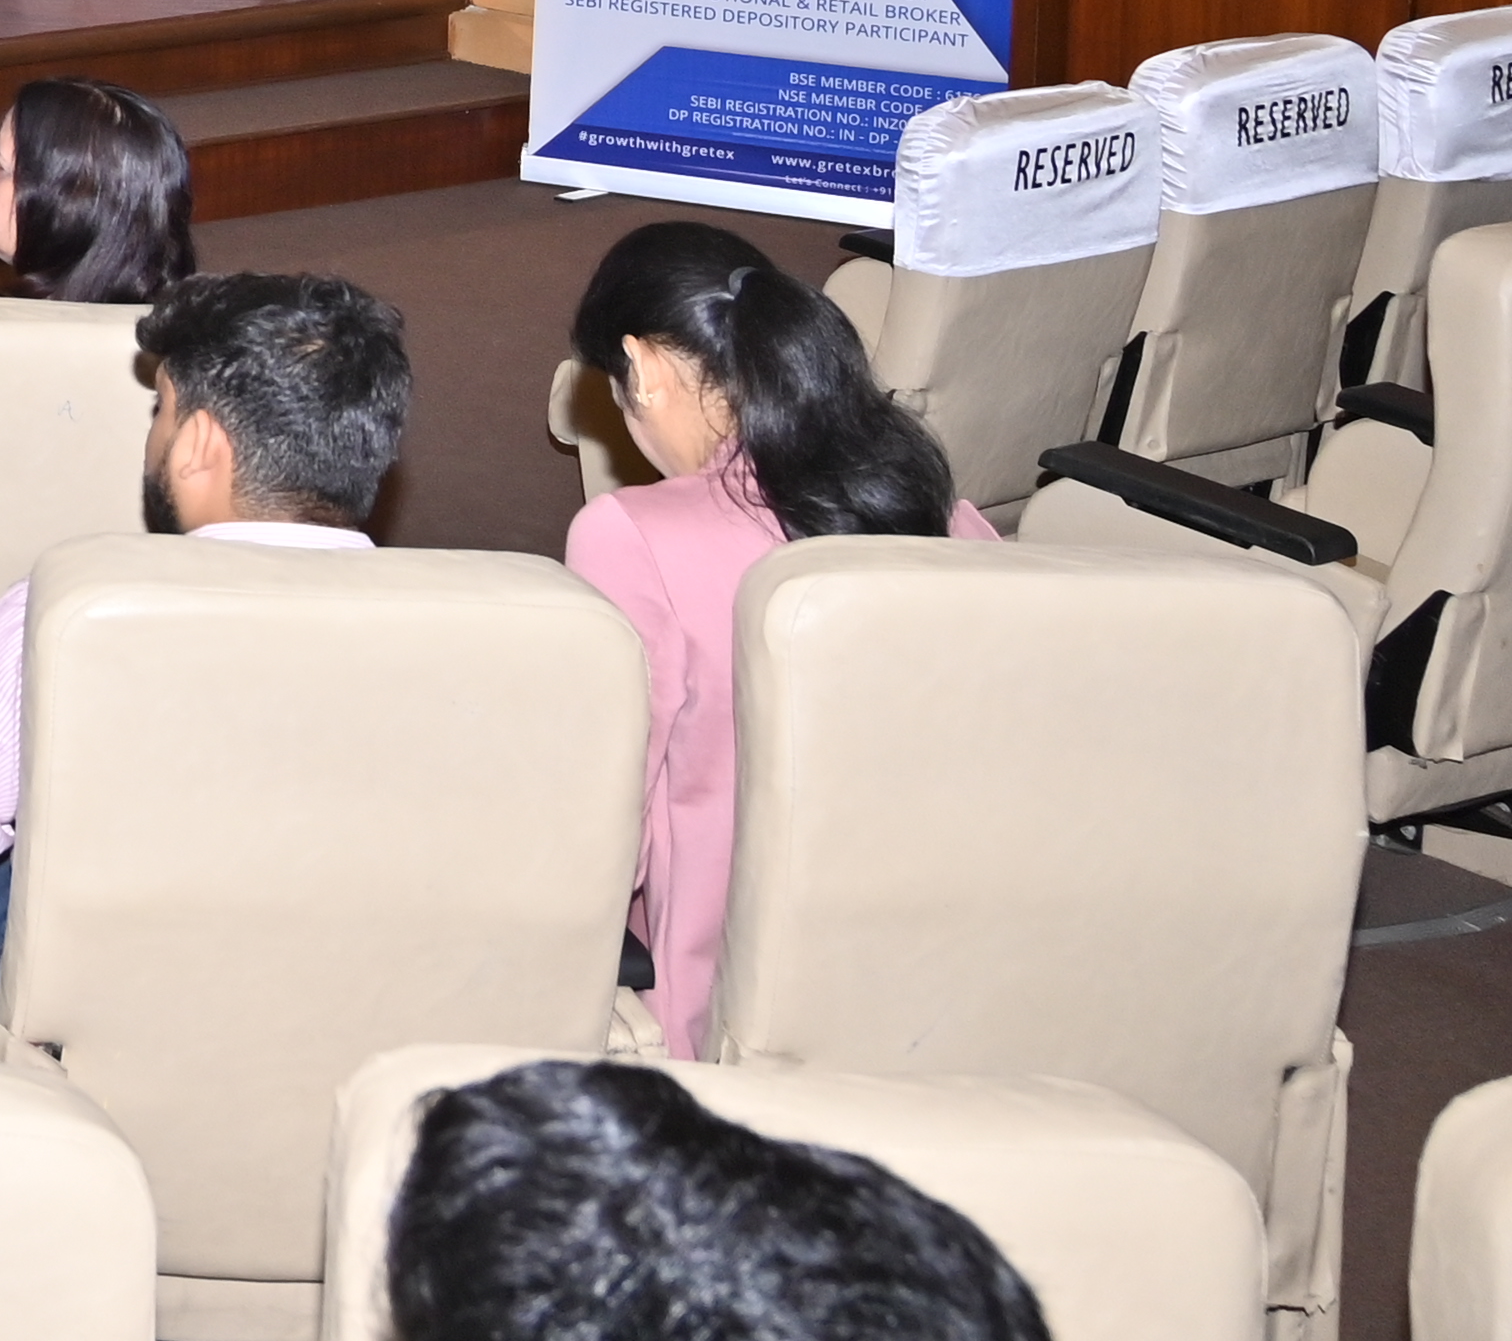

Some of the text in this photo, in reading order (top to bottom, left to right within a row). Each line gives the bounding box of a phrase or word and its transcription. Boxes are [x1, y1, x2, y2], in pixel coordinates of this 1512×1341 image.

[722, 8, 840, 34] DEPOSITORY
[845, 21, 969, 48] PARTICIPANT
[885, 4, 961, 26] BROKER
[778, 88, 922, 115] NSE MEMEBR CODE
[789, 72, 933, 100] BSE MEMBER CODE
[668, 108, 890, 145] DP REGISTRATION NO.: IN DP
[690, 95, 869, 127] SEBI REGISTRATION NO.:
[1237, 87, 1350, 147] RESERVED
[578, 130, 735, 160] #growthwithgretex
[1014, 131, 1136, 192] RESERVED
